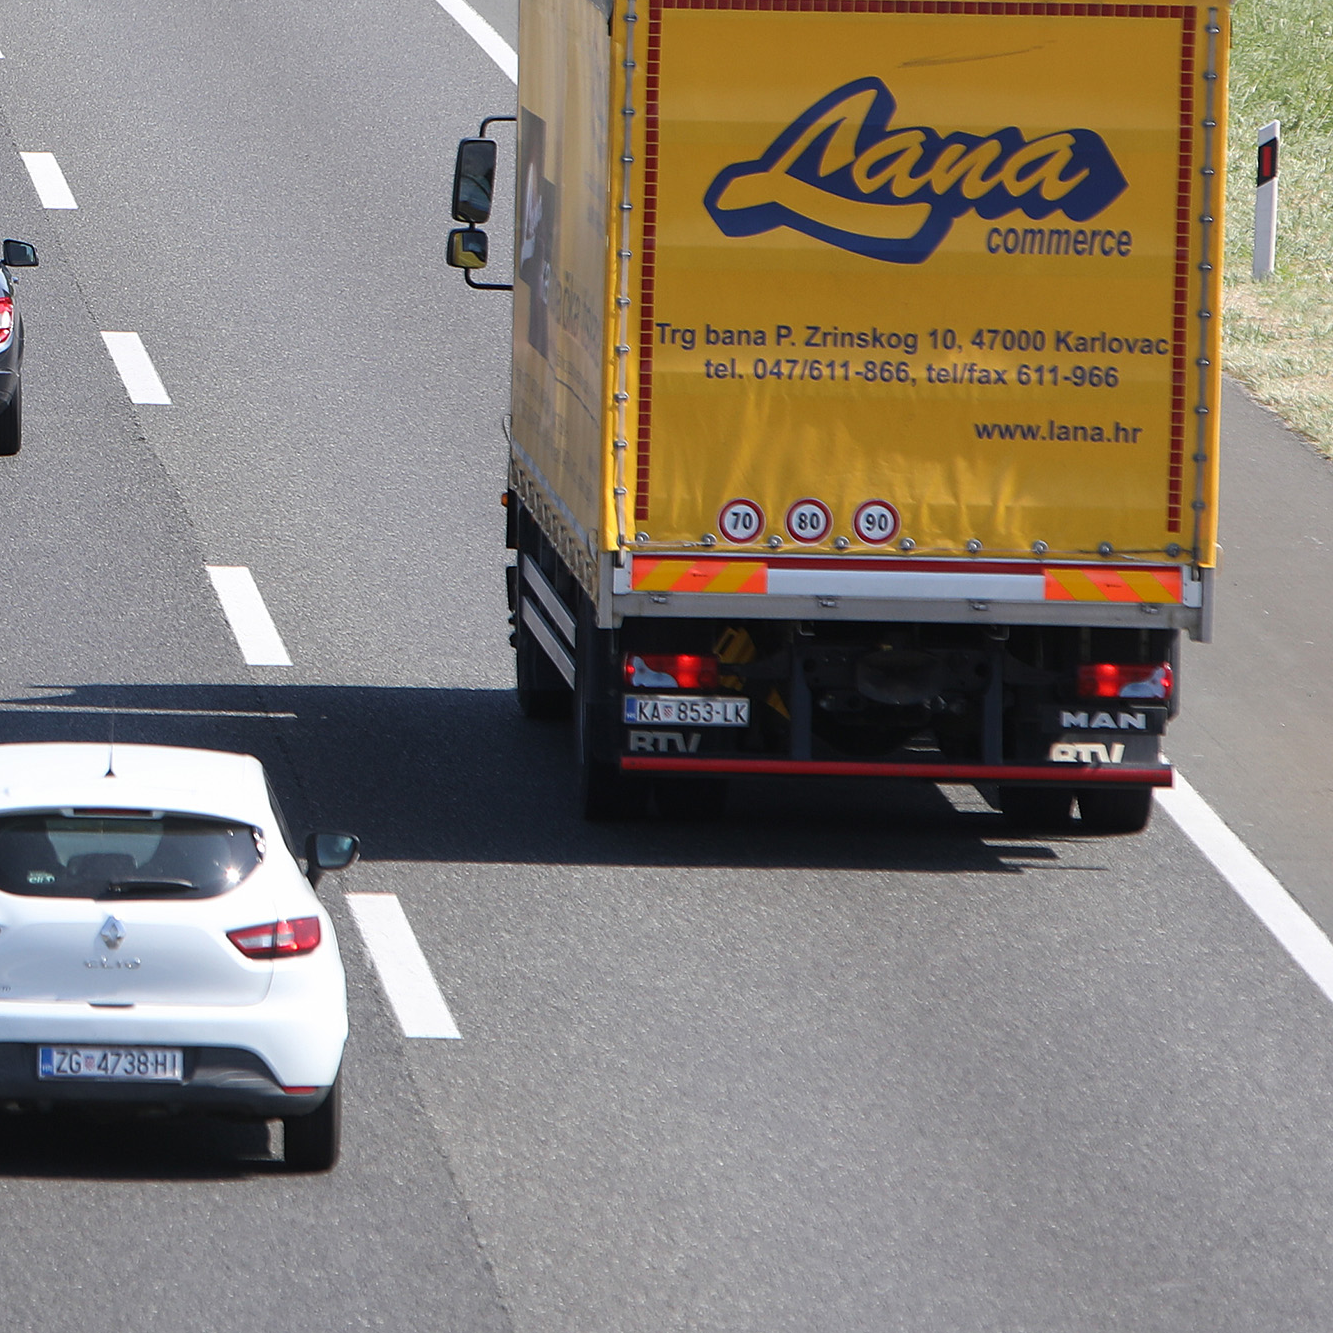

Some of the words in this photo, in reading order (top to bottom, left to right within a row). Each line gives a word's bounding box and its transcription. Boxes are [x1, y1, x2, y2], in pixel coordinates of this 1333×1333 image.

[704, 75, 1130, 265] Lana
[986, 226, 1132, 257] commerce
[655, 322, 696, 351] Trg
[705, 324, 767, 347] bana
[776, 325, 796, 347] P.
[805, 325, 918, 354] Zrinskog
[929, 329, 963, 353] 10,
[971, 329, 1046, 352] 47000
[1055, 331, 1170, 355] Karlovac
[704, 358, 744, 380] tel.
[753, 358, 917, 386] 047/611-866,
[927, 362, 1008, 385] tel/fax
[1017, 364, 1120, 388] 611-966
[974, 420, 1143, 444] www.lana.hr
[731, 512, 753, 530] 70
[798, 512, 820, 530] 80
[865, 513, 888, 532] 90
[638, 701, 661, 721] KA
[677, 702, 748, 723] 853-LK
[1060, 711, 1146, 730] MAN
[55, 1051, 82, 1075] ZG
[97, 1052, 177, 1076] 4738-HI
